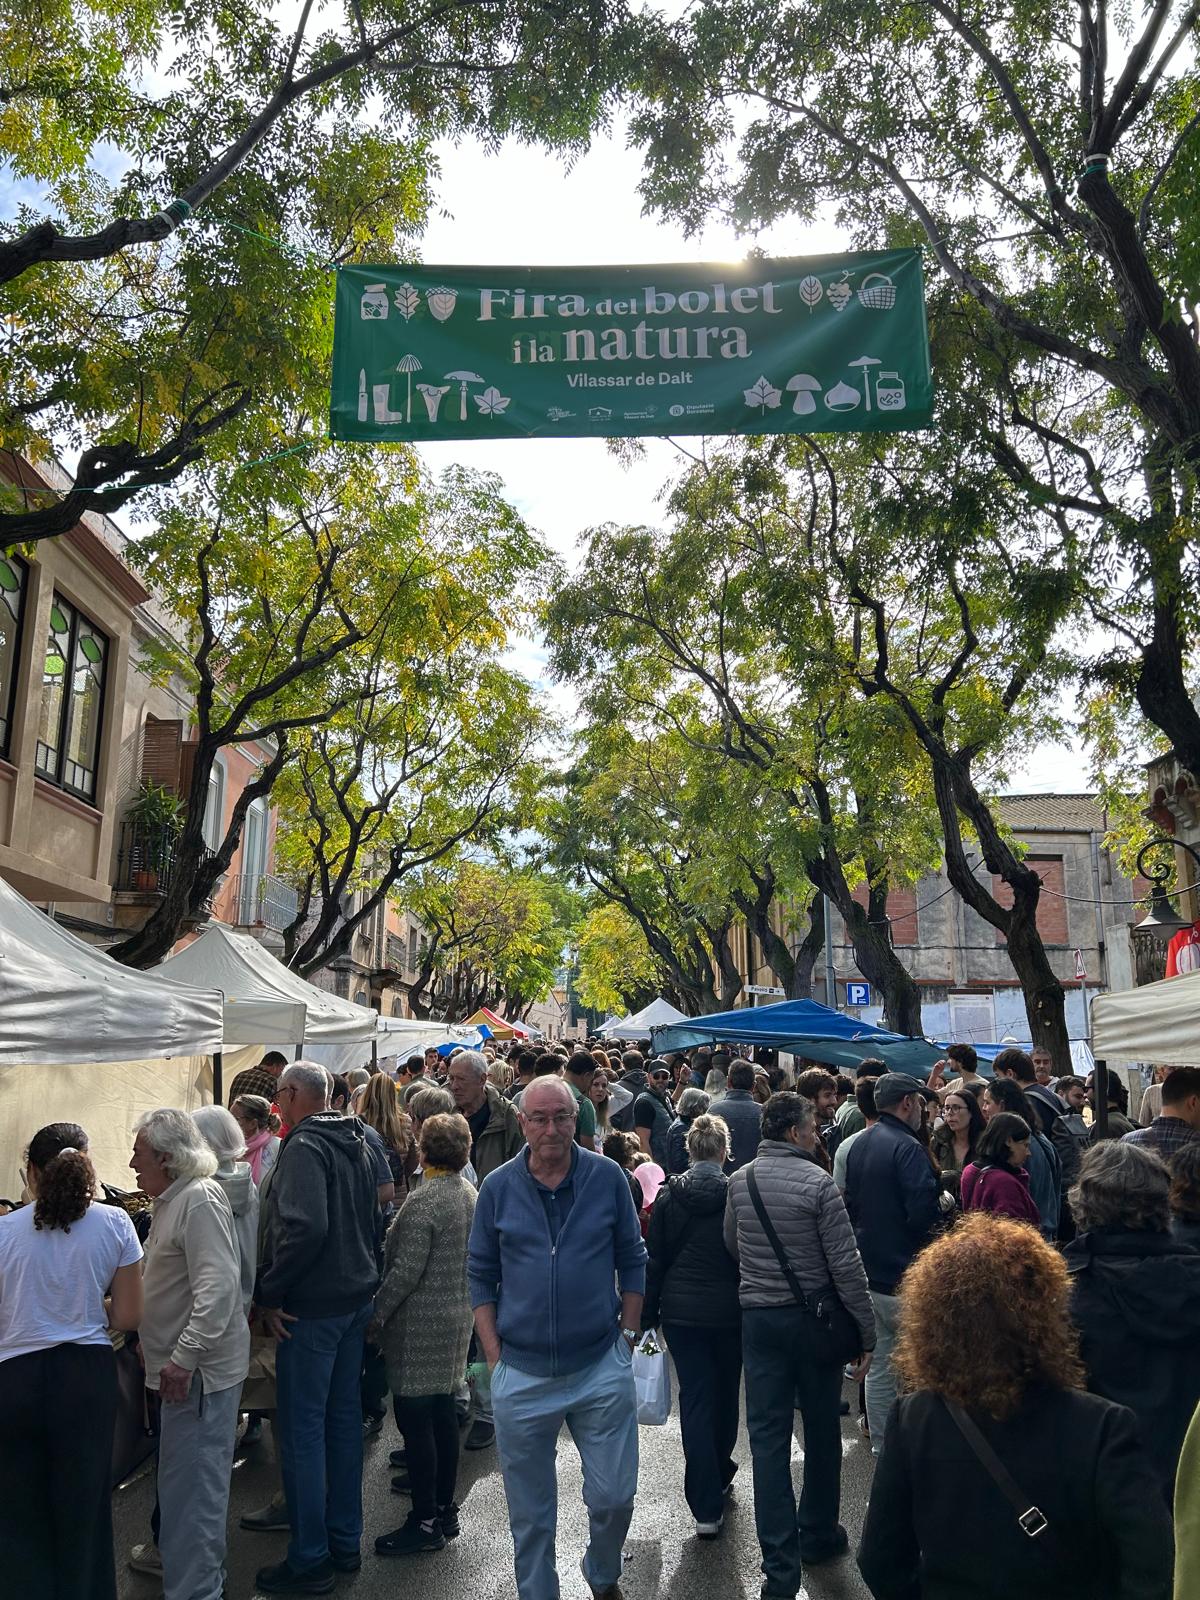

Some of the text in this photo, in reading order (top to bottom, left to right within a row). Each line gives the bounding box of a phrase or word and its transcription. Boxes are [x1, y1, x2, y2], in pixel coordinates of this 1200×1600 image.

[477, 281, 784, 321] Fira del bolet
[512, 320, 753, 364] i la natura
[566, 371, 694, 388] Vilassar de Dalt
[851, 985, 865, 1004] P
